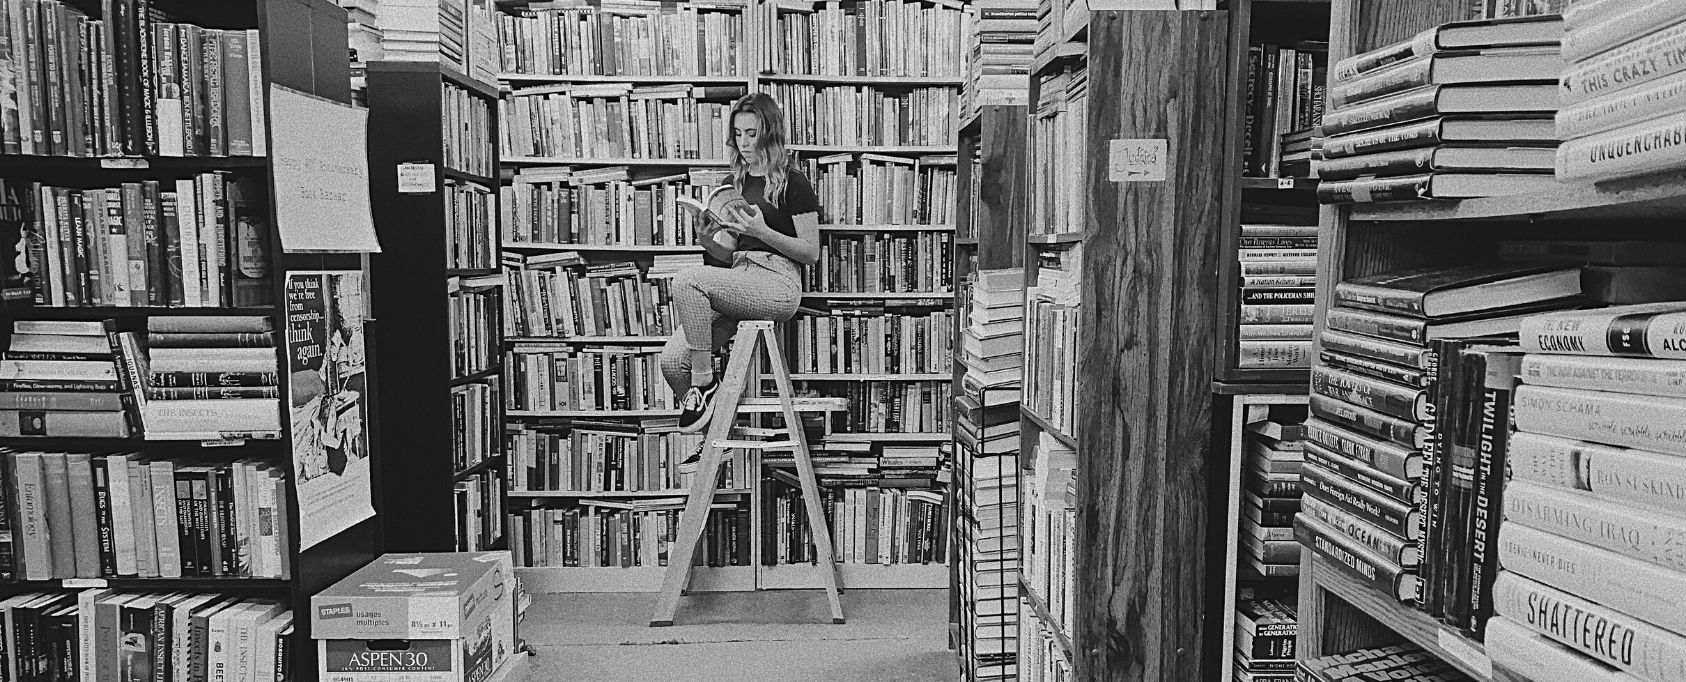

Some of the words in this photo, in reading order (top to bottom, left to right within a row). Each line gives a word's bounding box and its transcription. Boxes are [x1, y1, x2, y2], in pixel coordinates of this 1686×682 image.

[1581, 74, 1608, 94] THIS
[1614, 58, 1657, 83] CRAZY
[74, 217, 82, 236] LEARN
[76, 238, 84, 258] MAGIC
[288, 278, 293, 290] If
[294, 281, 304, 292] you
[305, 278, 320, 289] think
[289, 290, 304, 300] we're
[305, 289, 316, 300] free
[290, 300, 304, 312] from
[1274, 292, 1302, 300] POLICEMAN
[289, 322, 314, 344] think
[1538, 335, 1586, 352] ECONOMY
[127, 358, 140, 390] IGUANAS
[1430, 352, 1438, 381] GEORGE
[1522, 396, 1551, 410] SIMON
[1556, 400, 1601, 416] SCHAMA
[1480, 391, 1496, 476] TWILIGHT
[1421, 468, 1430, 488] THE
[1481, 472, 1486, 480] IN
[1320, 481, 1329, 492] Does
[1352, 496, 1366, 512] Really
[1434, 481, 1440, 496] TO
[24, 482, 38, 536] Entomology
[1418, 491, 1428, 527] DESERT
[1474, 496, 1488, 563] DESERT
[1512, 498, 1593, 534] DISARMING
[1600, 520, 1640, 552] IRAQ
[101, 527, 110, 552] SYSTEM
[1417, 530, 1426, 564] MYSTIC
[1315, 535, 1355, 569] STANDARDIZED
[1356, 558, 1376, 581] MINDS
[1558, 558, 1576, 574] DIES
[320, 606, 350, 616] STAPLES
[356, 611, 382, 619] usages
[157, 608, 165, 641] AFRICAN
[356, 619, 390, 627] multiples
[1527, 591, 1635, 666] SHATTERED
[194, 626, 204, 660] Insects
[156, 643, 165, 670] INSECT
[194, 662, 204, 672] in
[348, 652, 404, 667] ASPEN
[405, 652, 428, 667] 30
